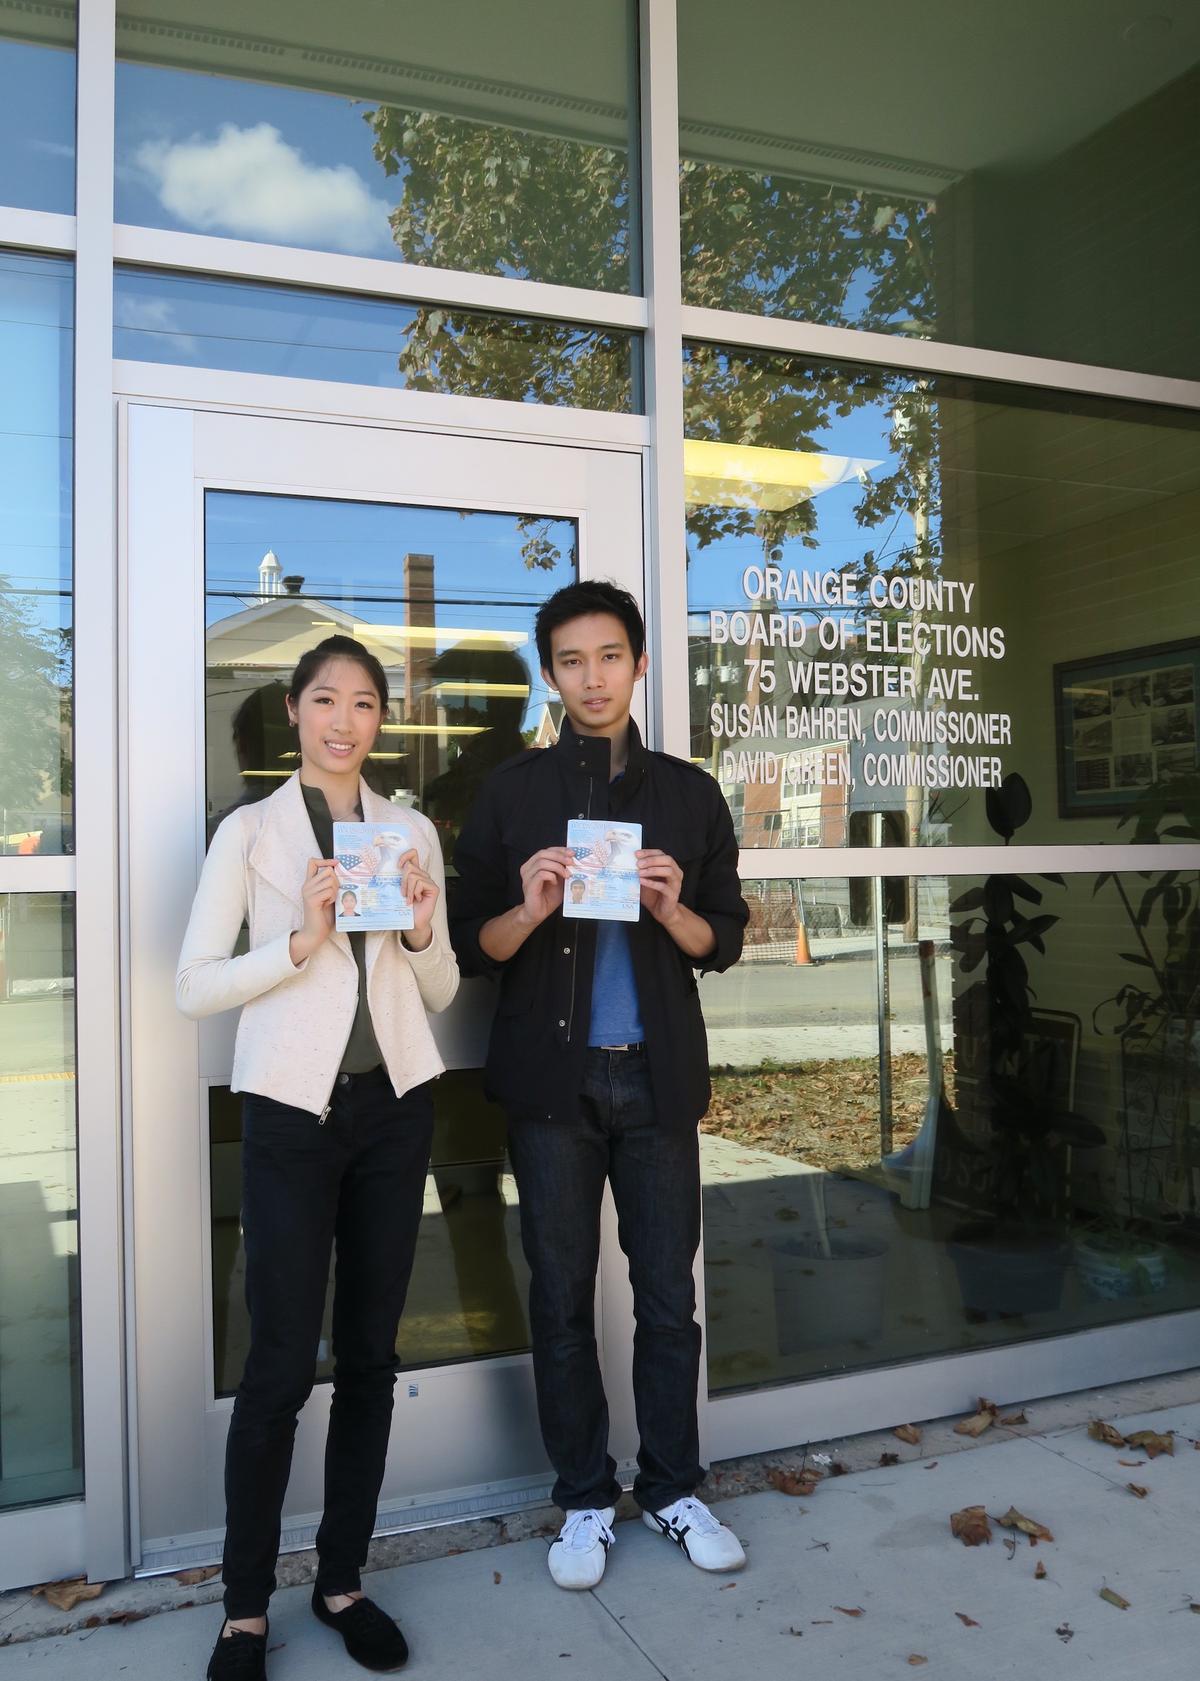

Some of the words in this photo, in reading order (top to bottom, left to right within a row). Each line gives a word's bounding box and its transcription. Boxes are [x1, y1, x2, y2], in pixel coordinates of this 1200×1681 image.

[743, 565, 858, 606] ORANGE
[869, 576, 975, 614] COUNTY
[709, 610, 807, 648] BOARD
[818, 616, 855, 651] OF
[866, 619, 1006, 660] ELECTIONS
[743, 659, 777, 693] 75
[787, 661, 916, 698] WEBSTER
[927, 667, 980, 701] AVE.
[710, 703, 777, 739] SUSAN
[786, 706, 867, 747] BAHREN,
[873, 708, 1012, 745] COMMISSIONER
[722, 751, 778, 785] DAVID
[786, 752, 856, 791] GREEN,
[863, 753, 1003, 788] COMMISSIONER
